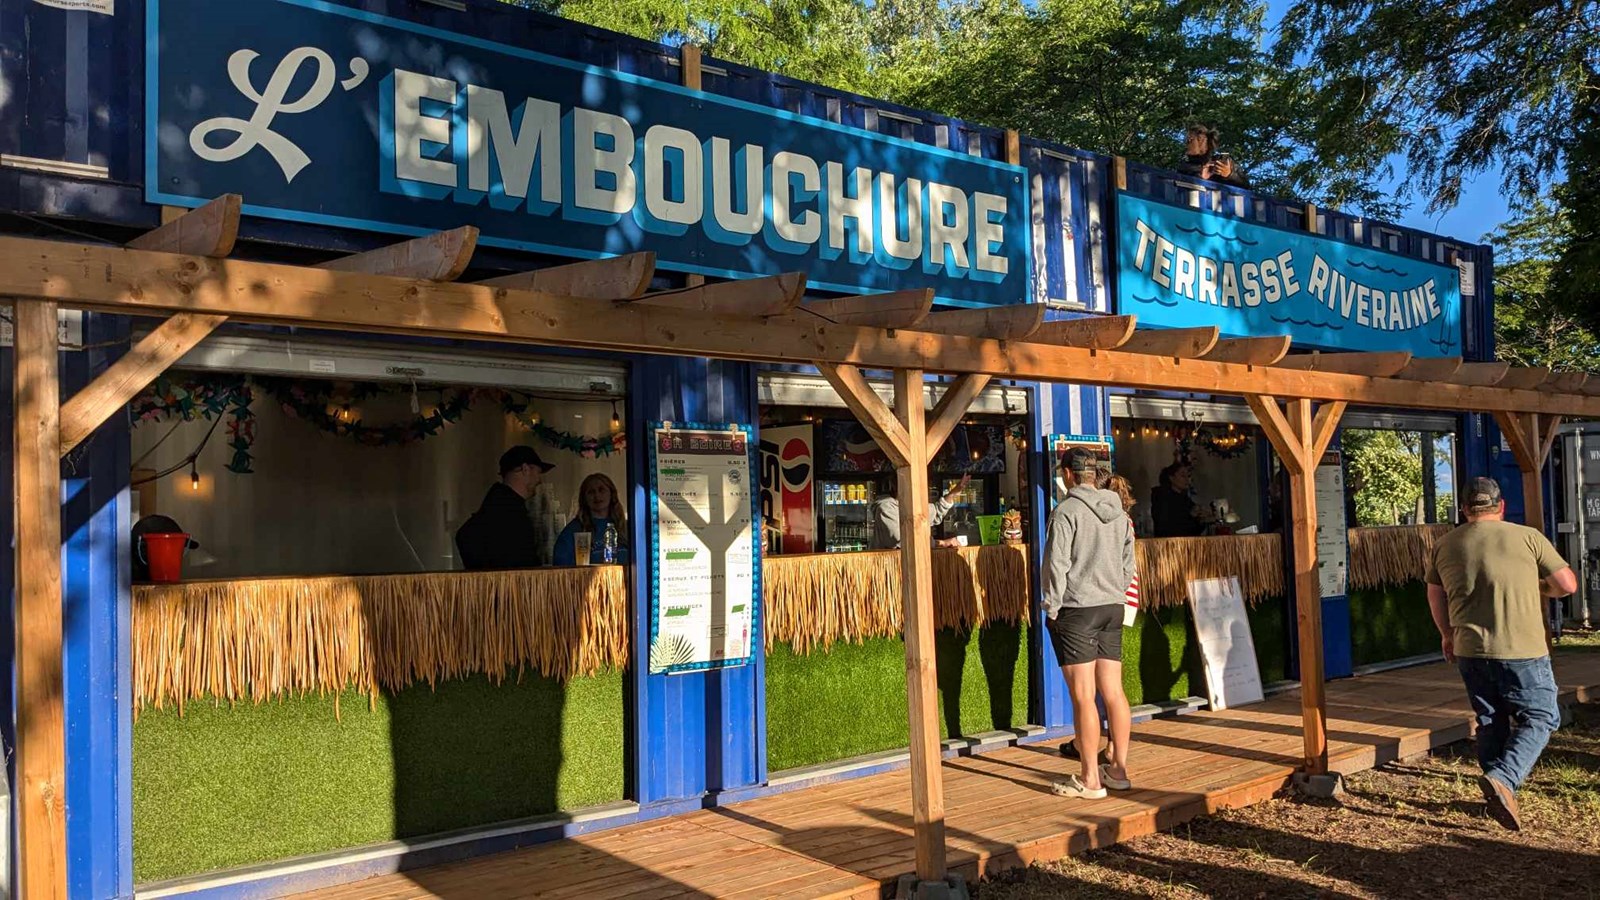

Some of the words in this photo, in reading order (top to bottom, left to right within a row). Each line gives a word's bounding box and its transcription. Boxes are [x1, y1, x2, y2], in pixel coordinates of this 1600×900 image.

[189, 46, 1010, 280] L'EMBOUCHURE
[1133, 217, 1300, 308] TERRASSE
[1307, 252, 1442, 332] RIVERAINE
[690, 439, 732, 450] BOIRE
